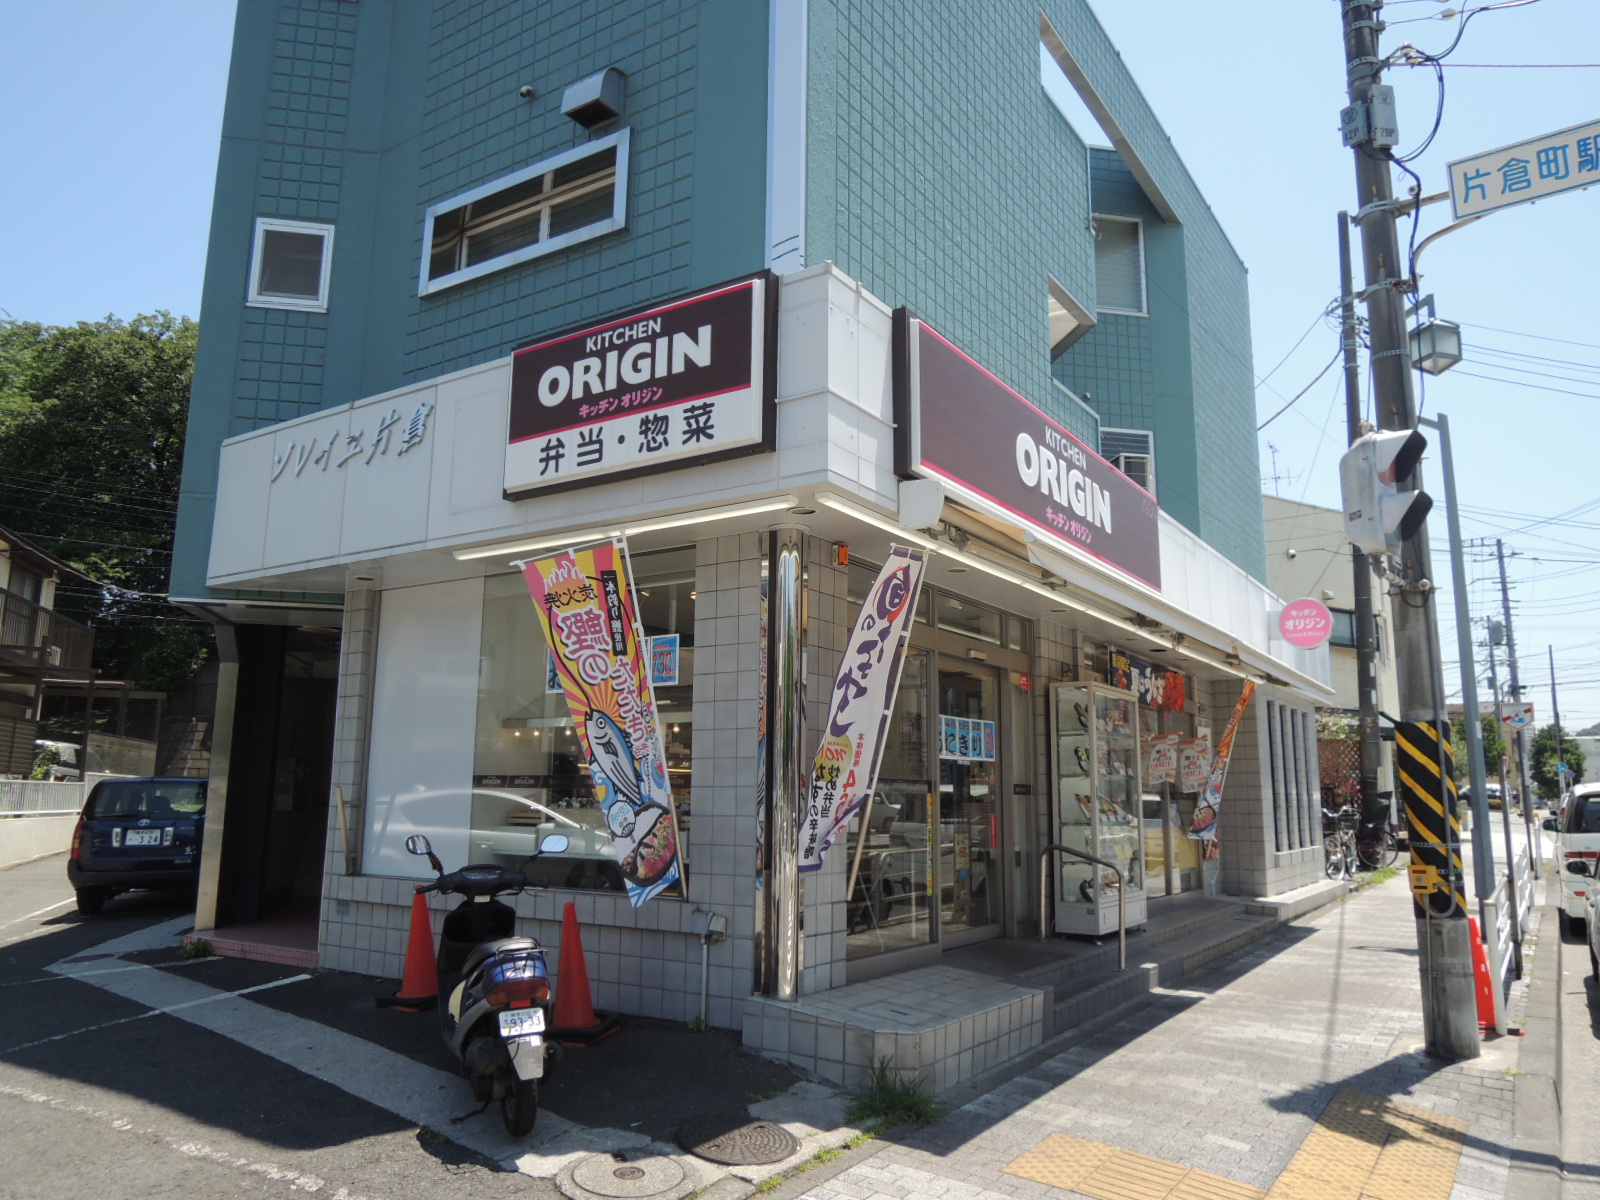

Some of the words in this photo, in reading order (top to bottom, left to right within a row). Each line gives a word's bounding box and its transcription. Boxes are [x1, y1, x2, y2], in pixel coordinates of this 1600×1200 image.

[586, 316, 662, 353] KITCHEN
[537, 324, 712, 407] ORIGIN
[579, 397, 619, 418] キッチン
[620, 386, 663, 409] オリジン
[539, 402, 715, 476] 弁当・惣菜
[1045, 425, 1087, 471] KITCHEN
[1015, 432, 1112, 535] ORIGIN
[1284, 617, 1326, 630] オリジン
